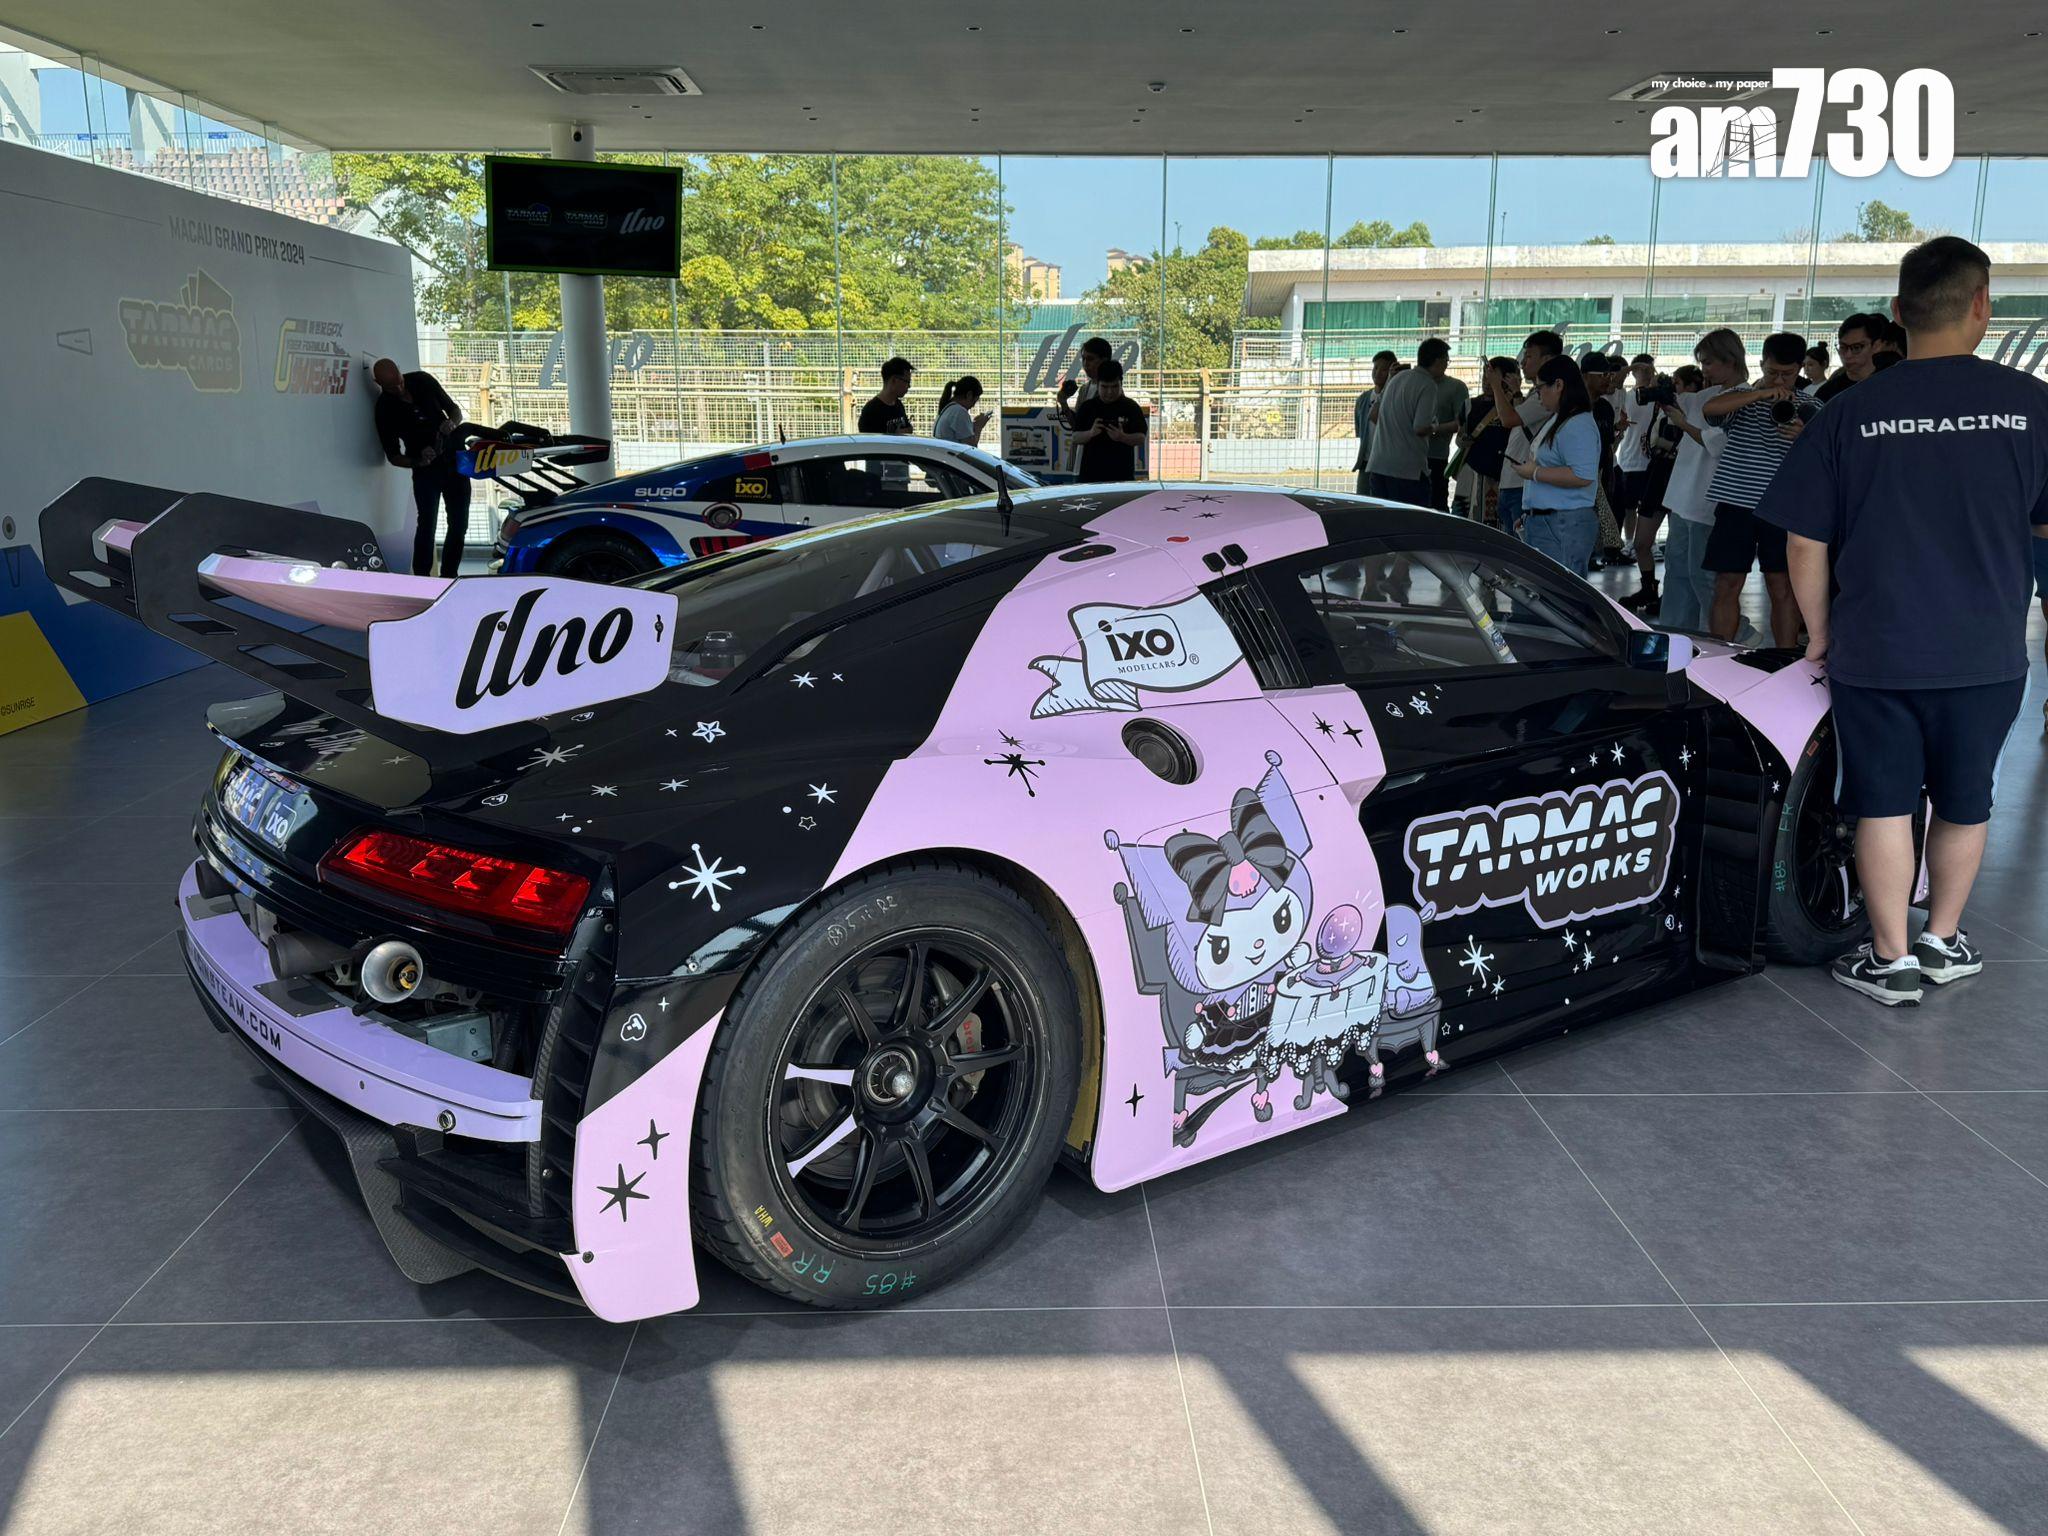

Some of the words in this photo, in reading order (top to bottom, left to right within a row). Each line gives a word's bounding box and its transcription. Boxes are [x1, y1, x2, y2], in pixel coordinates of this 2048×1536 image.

[168, 215, 213, 247] MACAU
[214, 225, 253, 255] GRAND
[254, 234, 280, 260] PRIX
[279, 240, 305, 265] 2024
[1860, 414, 2028, 438] UNORACING
[634, 487, 687, 497] SUGO
[1098, 620, 1175, 662] ixo
[1117, 660, 1177, 674] MODELCARS
[1778, 802, 1794, 832] FR
[1416, 786, 1663, 887] TARMAC
[1535, 848, 1653, 897] WORKS
